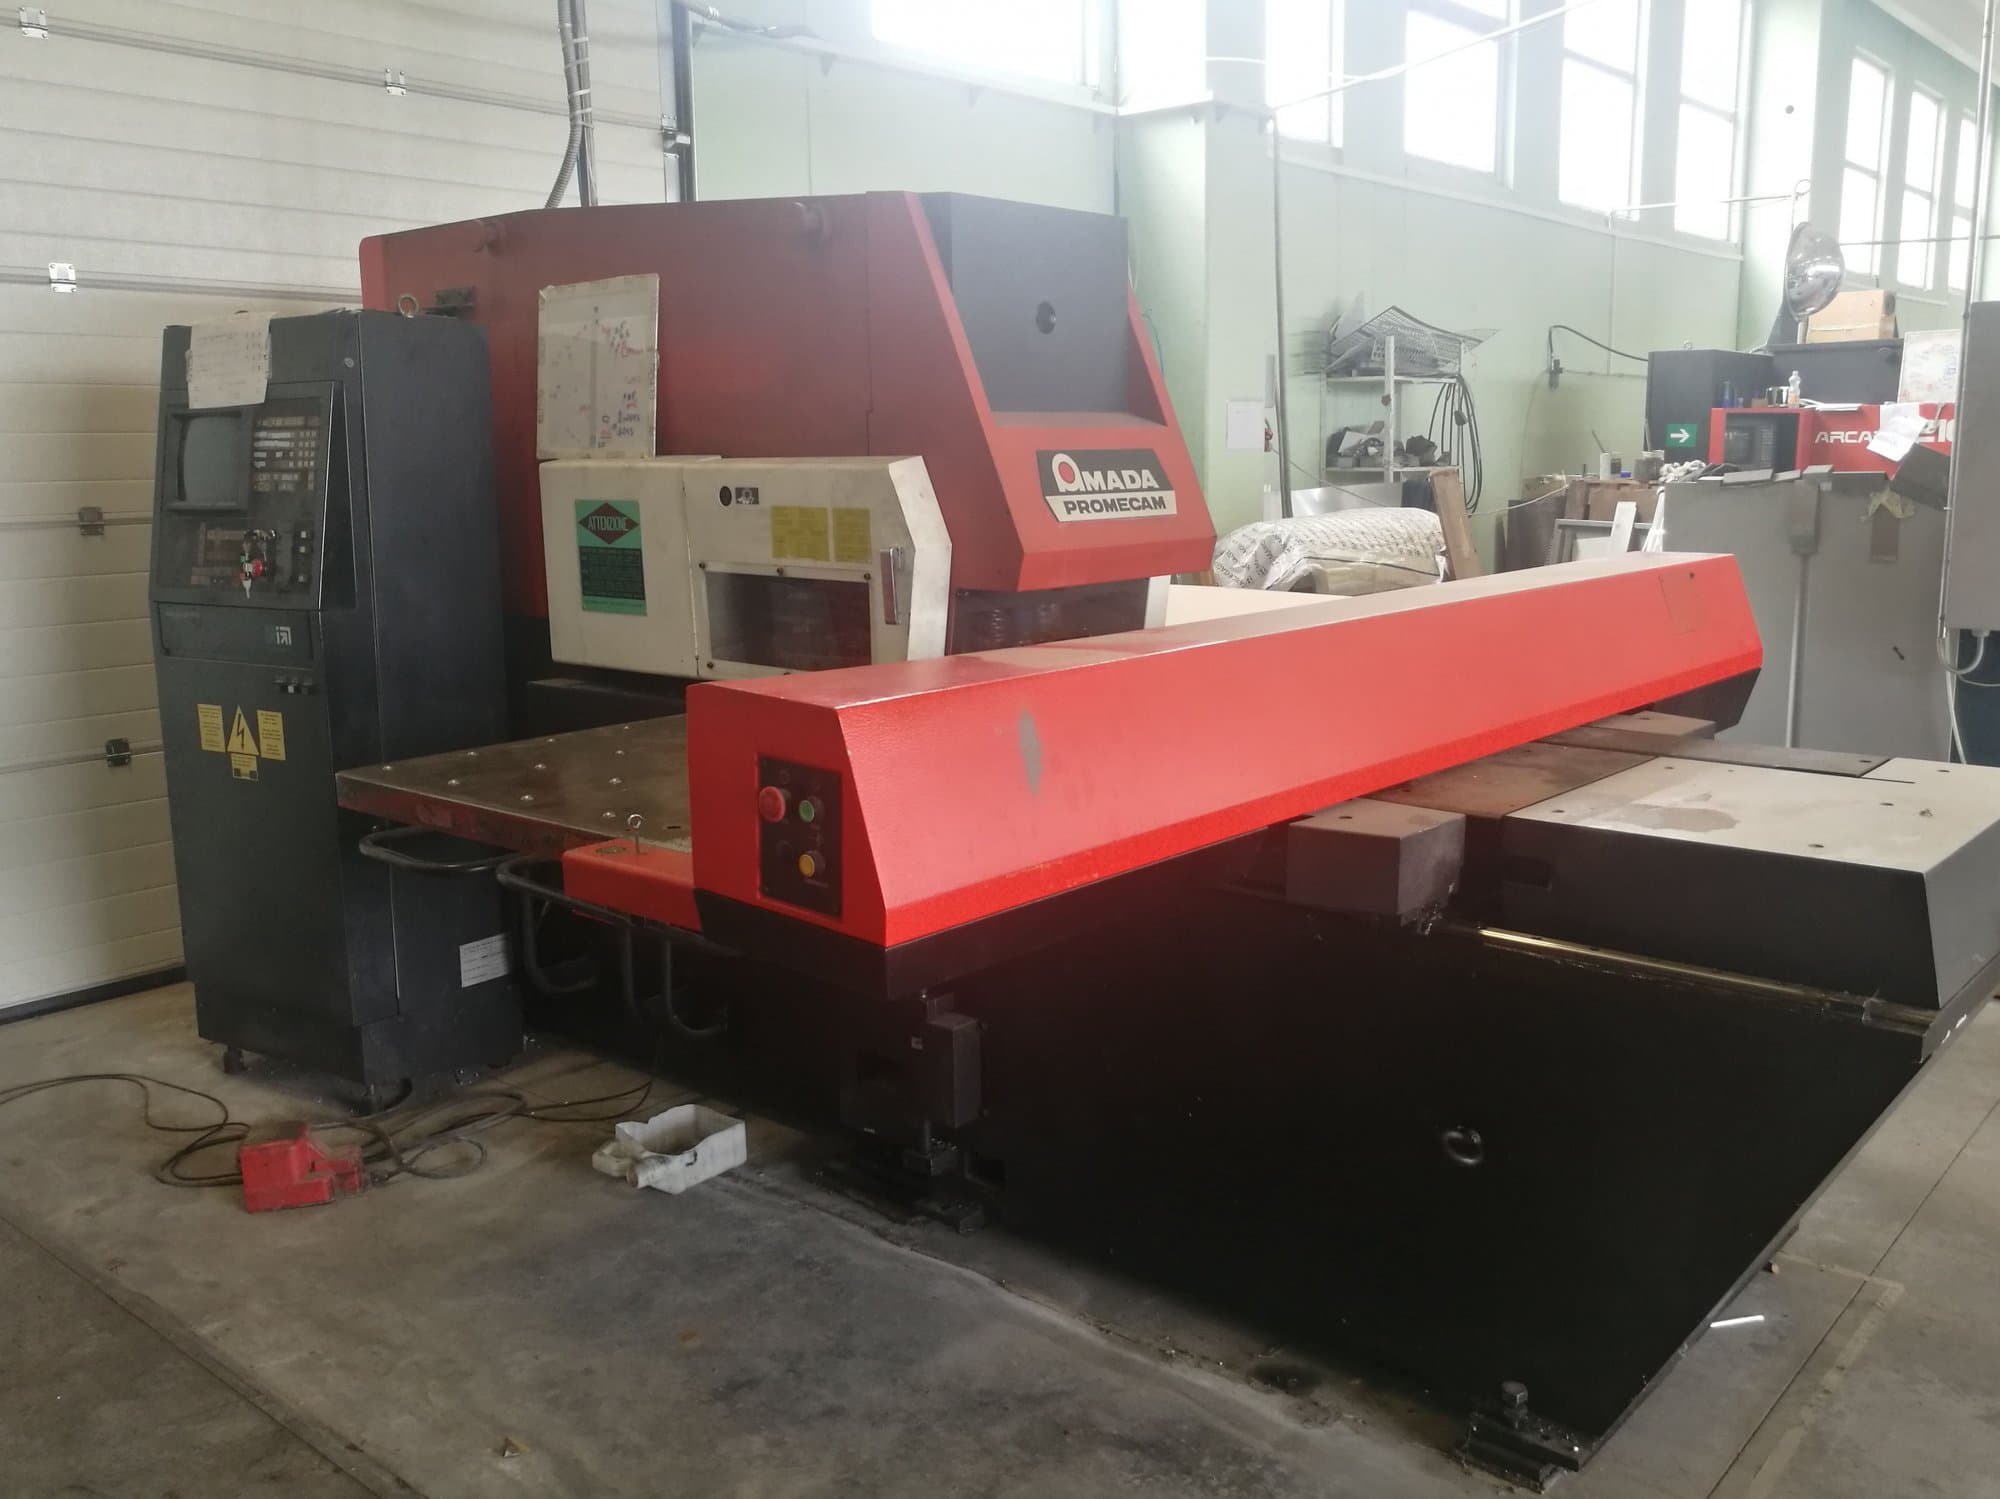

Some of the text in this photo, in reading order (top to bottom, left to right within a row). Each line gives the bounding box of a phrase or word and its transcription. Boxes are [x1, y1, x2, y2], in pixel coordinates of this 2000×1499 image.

[1814, 430, 1880, 444] ARCA
[1051, 453, 1159, 492] AMADA
[1063, 496, 1166, 515] PROMECAM
[588, 515, 629, 531] ATTENZIONE
